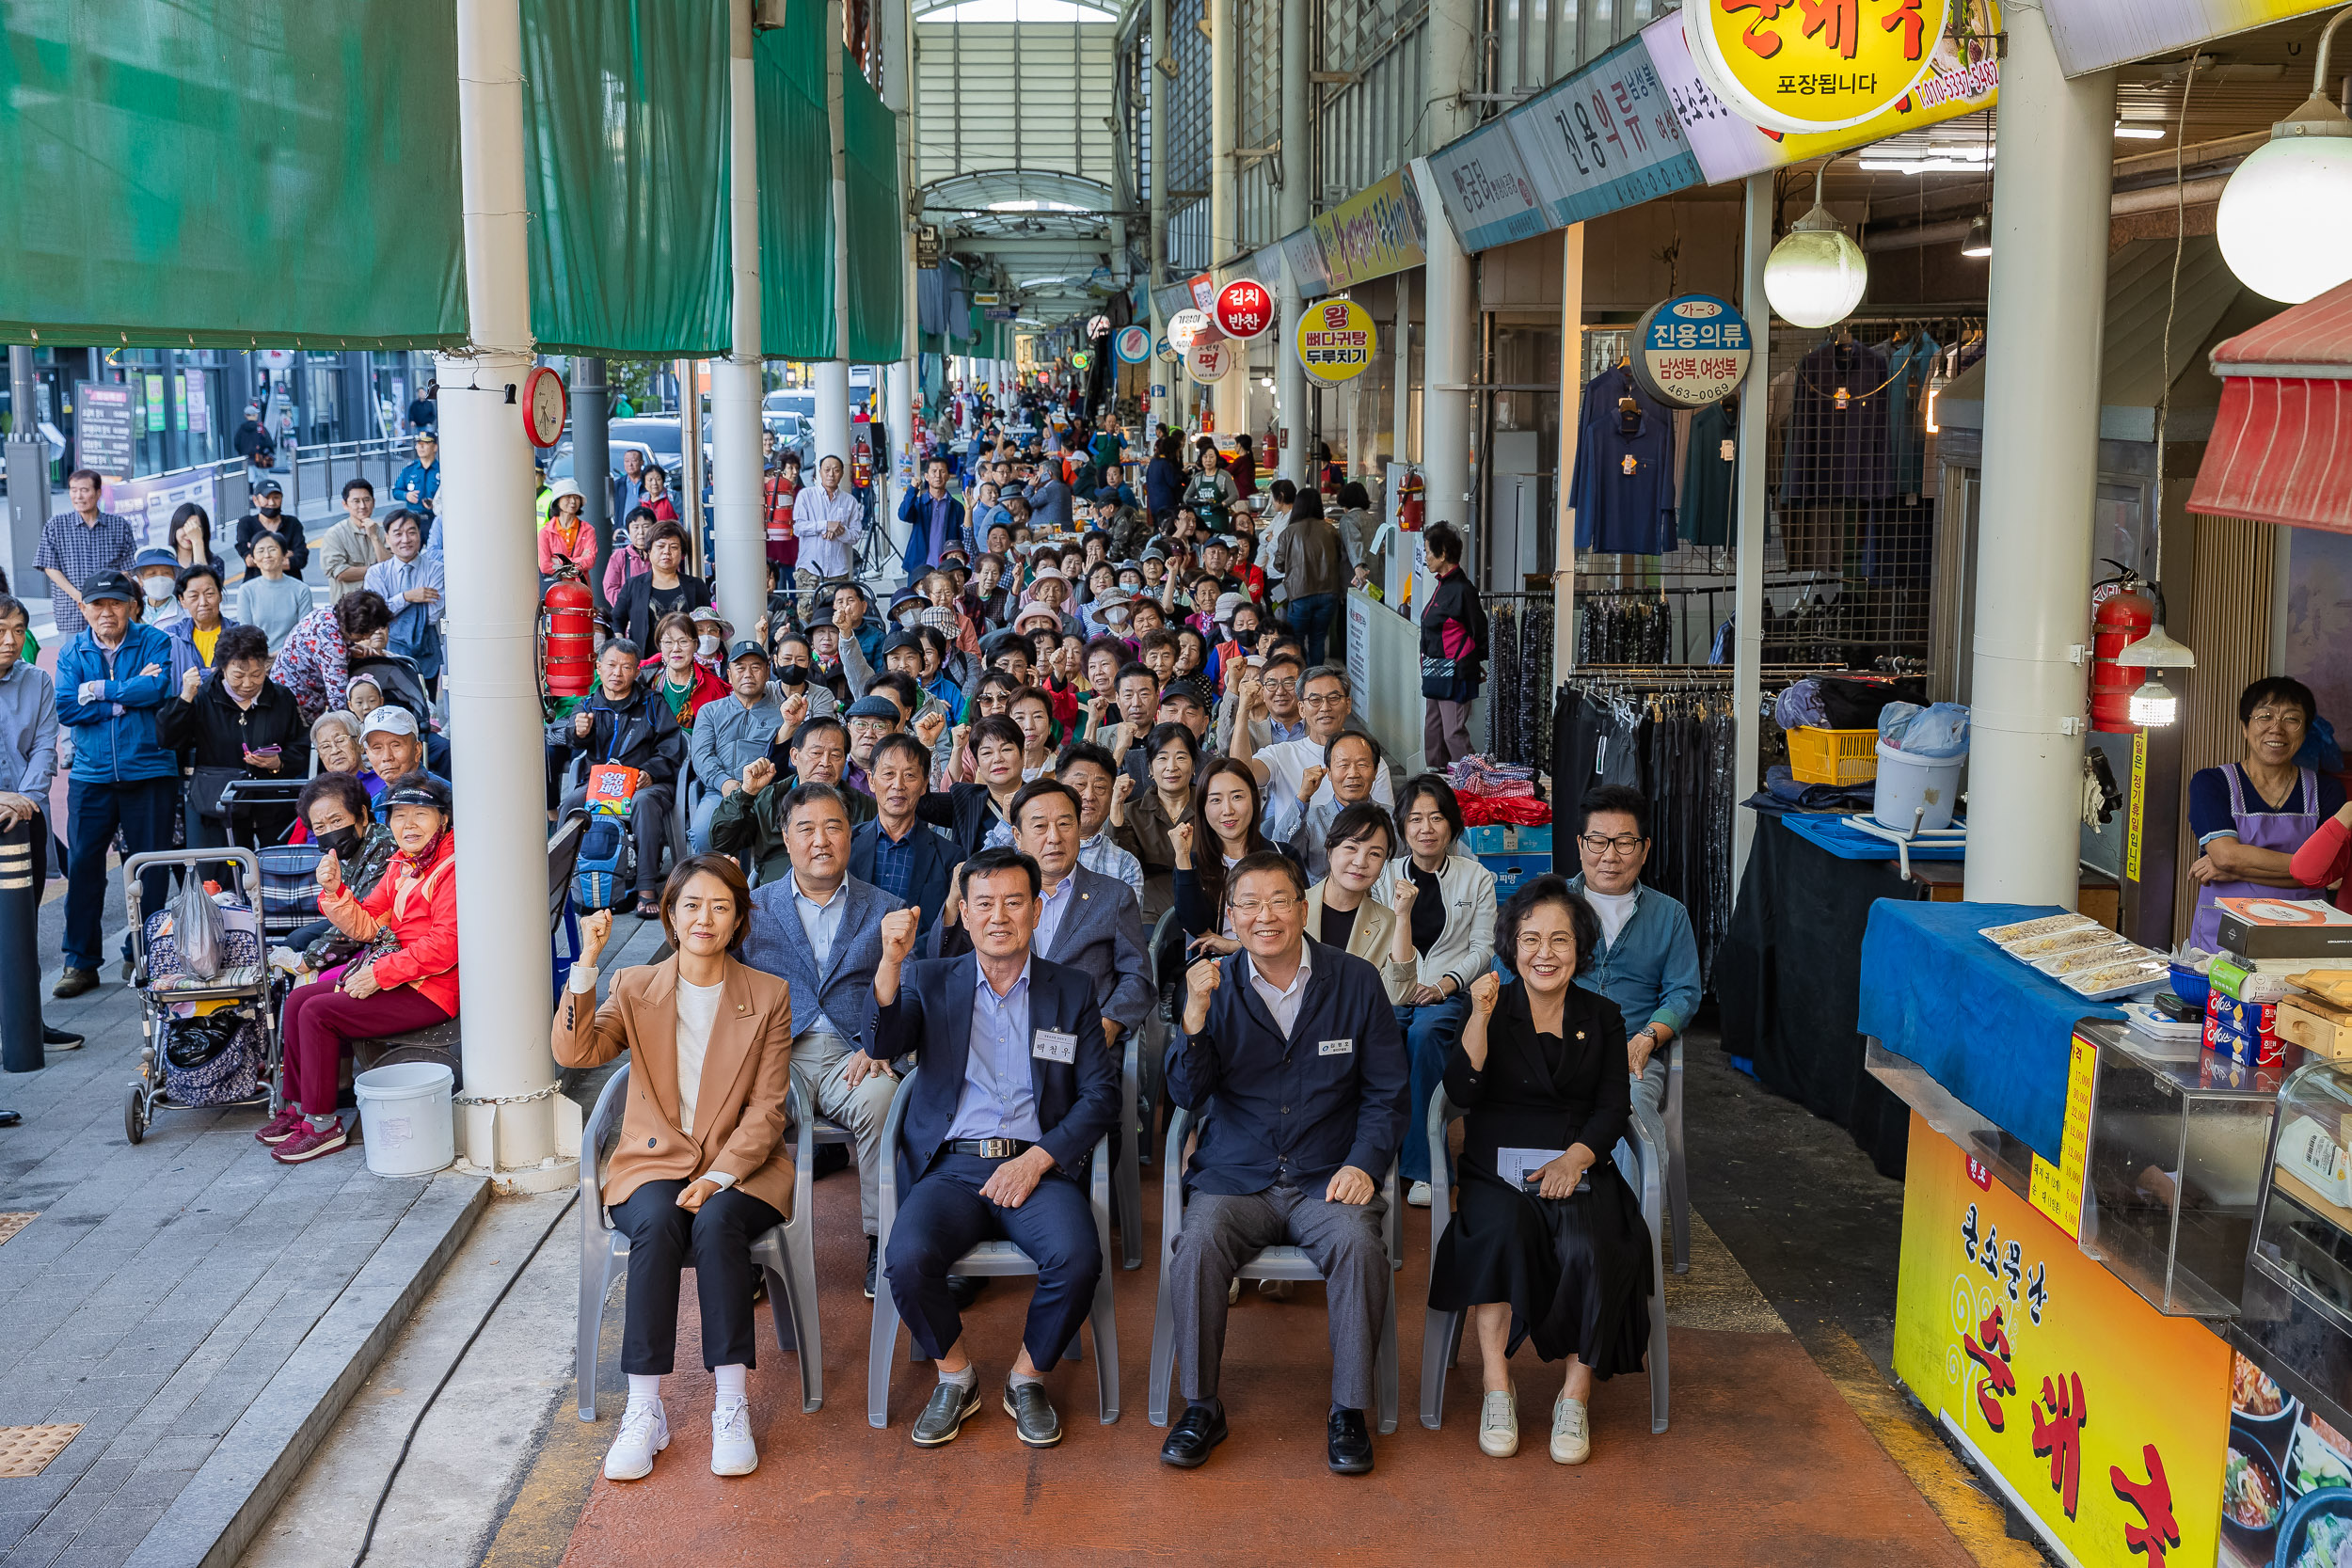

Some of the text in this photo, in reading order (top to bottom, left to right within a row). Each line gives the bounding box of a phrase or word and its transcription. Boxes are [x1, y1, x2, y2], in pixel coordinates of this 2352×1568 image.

[1625, 63, 1659, 102] 남성복
[1776, 72, 1878, 95] 포장됩니다
[1229, 288, 1260, 307] 김치
[1228, 312, 1261, 330] 반찬
[1323, 304, 1349, 329] 왕
[1306, 331, 1367, 347] 뼈다귀탕
[1654, 324, 1744, 349] 진용의류
[1199, 352, 1220, 372] 떡
[1306, 348, 1367, 365] 두루치기
[1667, 383, 1729, 400] 463-0069
[600, 771, 627, 784] 올영
[596, 784, 625, 797] 세일
[2210, 995, 2233, 1014] 에이스
[2207, 1026, 2233, 1045] 에이스
[2074, 1069, 2090, 1088] 17,000
[2071, 1105, 2087, 1124] 22,000
[2070, 1124, 2086, 1144] 12,000
[2067, 1145, 2083, 1164] 12,000
[2066, 1188, 2079, 1207] 6,000
[2064, 1211, 2077, 1227] 4,000
[1962, 1202, 2049, 1327] 큰소문난
